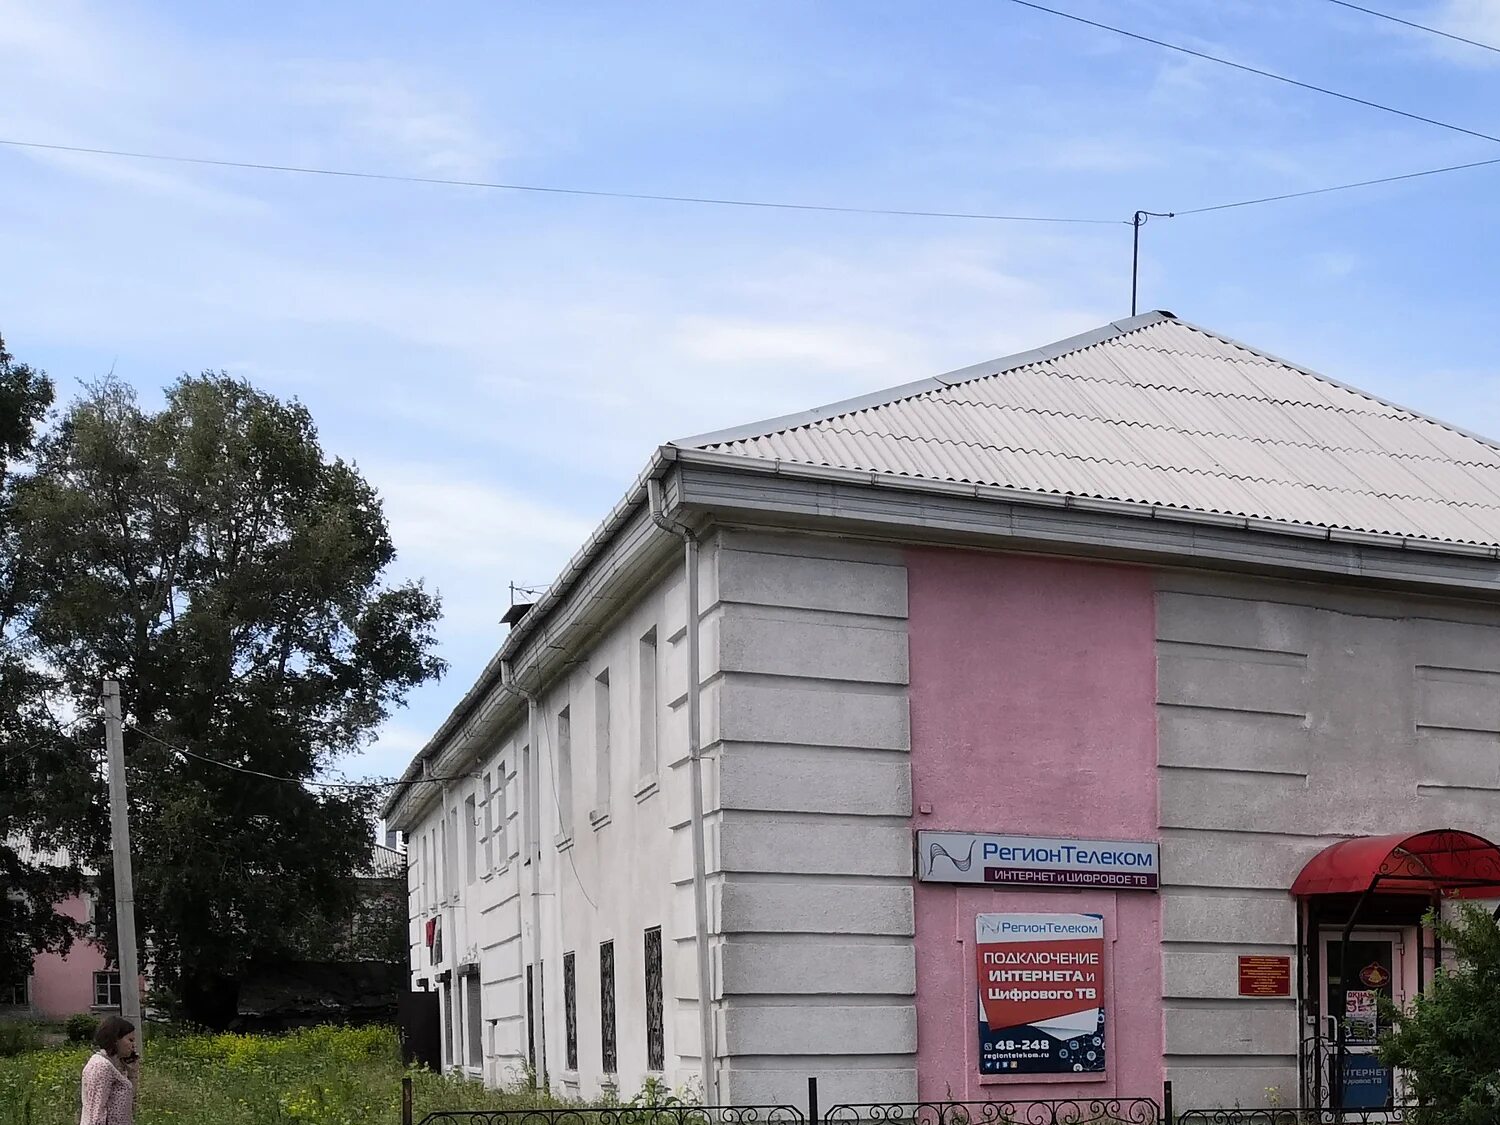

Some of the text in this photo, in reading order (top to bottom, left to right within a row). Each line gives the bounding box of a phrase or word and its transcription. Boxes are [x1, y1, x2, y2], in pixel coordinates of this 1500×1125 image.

[983, 843, 1152, 866] РегионТелеком
[994, 870, 1056, 881] ИНТЕРНЕТ
[1066, 873, 1131, 885] ЦИФРОВОЕ
[1133, 875, 1148, 885] ТВ
[1002, 922, 1098, 934] РегионТелеком
[984, 952, 1099, 965] ПОДКЛЮЧЕНИЕ
[989, 970, 1083, 982] ИНТЕРНЕТА
[988, 988, 1096, 1002] Цифрового ТВ
[995, 1040, 1050, 1051] 48-248
